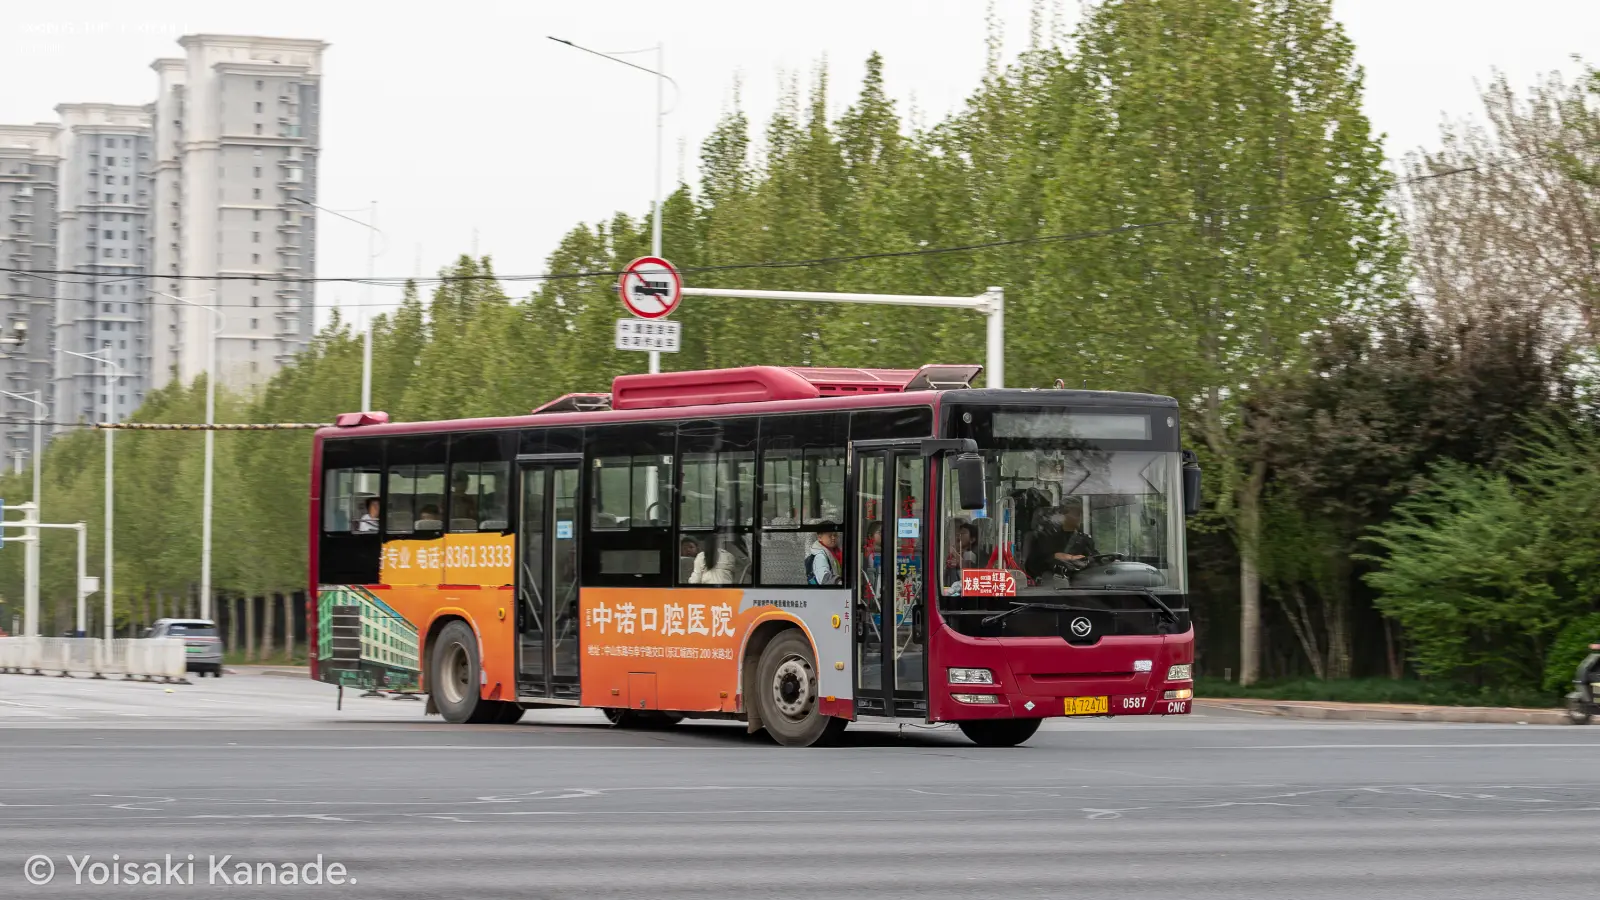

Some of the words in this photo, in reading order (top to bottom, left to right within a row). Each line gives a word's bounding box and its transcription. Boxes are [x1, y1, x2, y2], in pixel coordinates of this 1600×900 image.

[964, 576, 980, 591] 龙泉
[1006, 576, 1015, 593] 2
[592, 601, 736, 638] 中诺口腔医院
[1123, 697, 1147, 709] 0587
[1168, 701, 1186, 713] CNG
